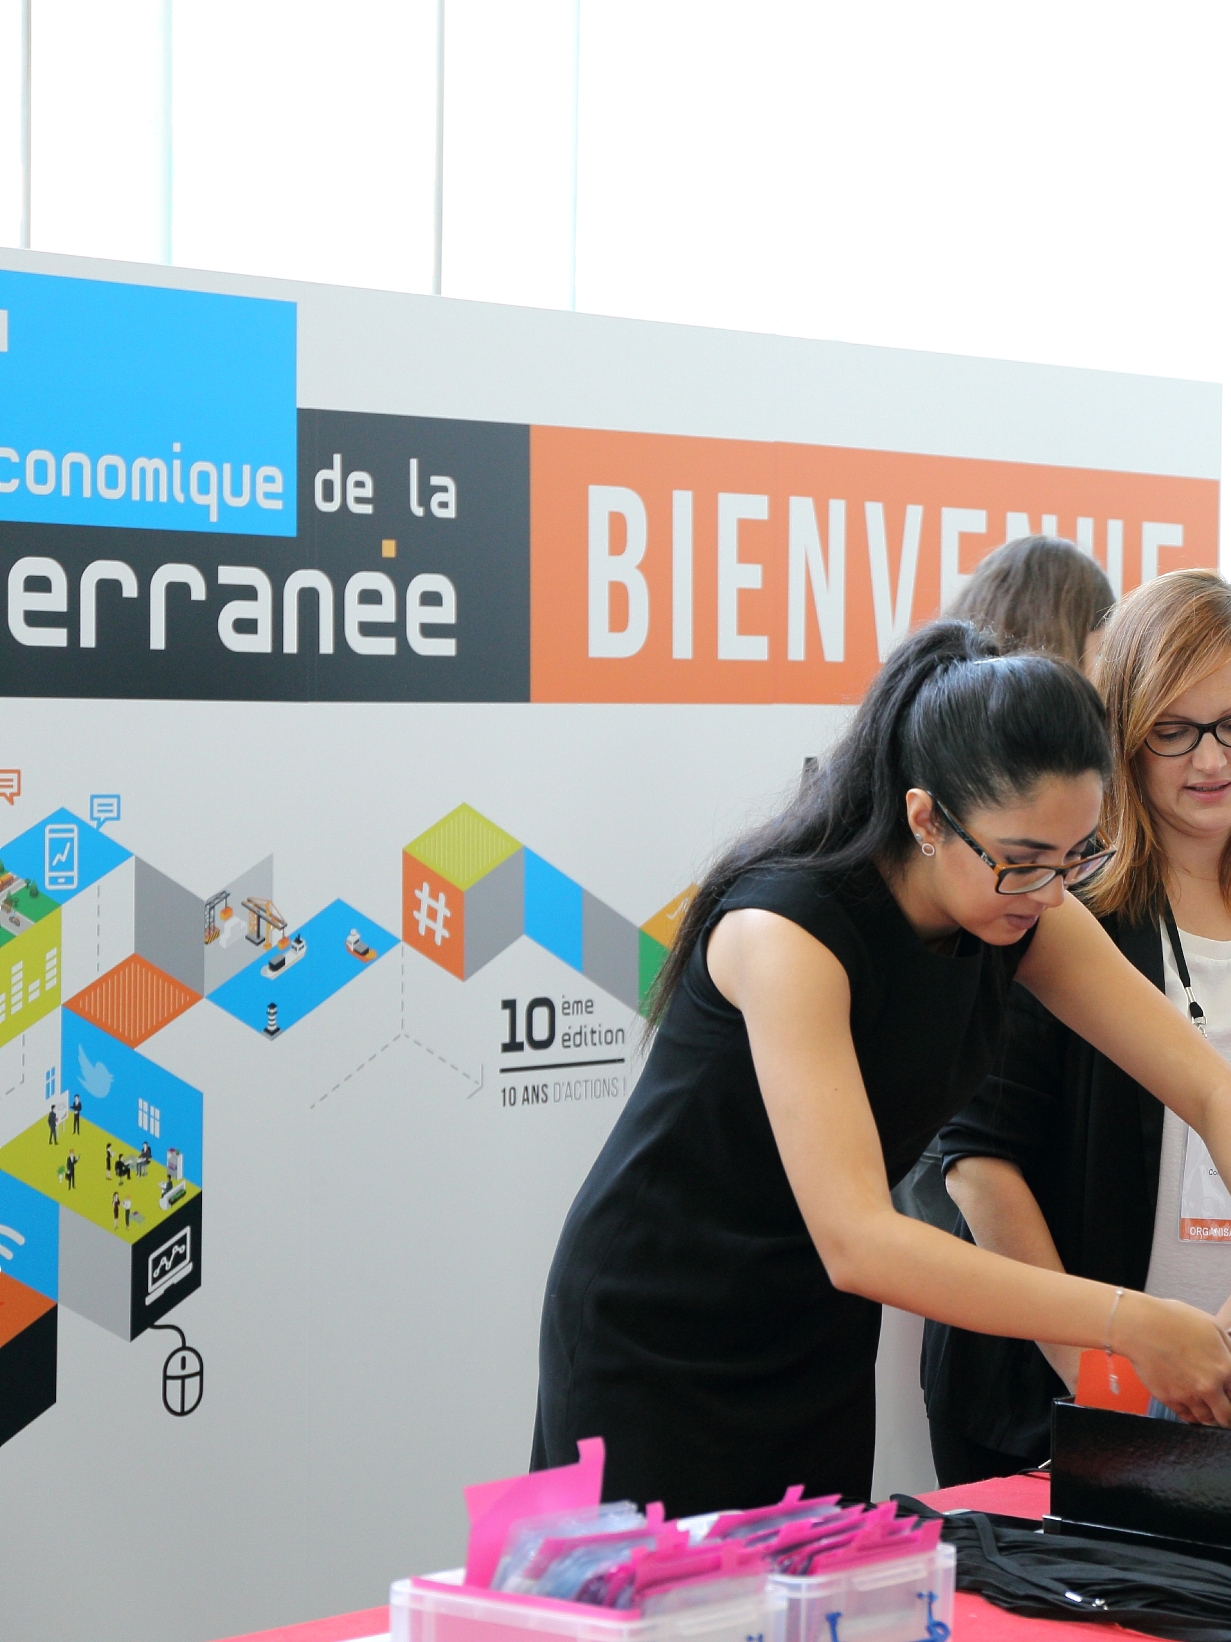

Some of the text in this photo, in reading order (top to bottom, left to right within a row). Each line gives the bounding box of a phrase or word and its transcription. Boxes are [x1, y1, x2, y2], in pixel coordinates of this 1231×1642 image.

[314, 453, 374, 514] de
[409, 457, 457, 519] la
[7, 538, 457, 657] erranée
[587, 484, 1184, 663] BIENVE
[501, 997, 556, 1053] 10
[562, 1025, 625, 1049] édition
[501, 1087, 516, 1107] 10
[521, 1084, 549, 1106] ANS
[553, 1078, 619, 1103] D'ACTIONS
